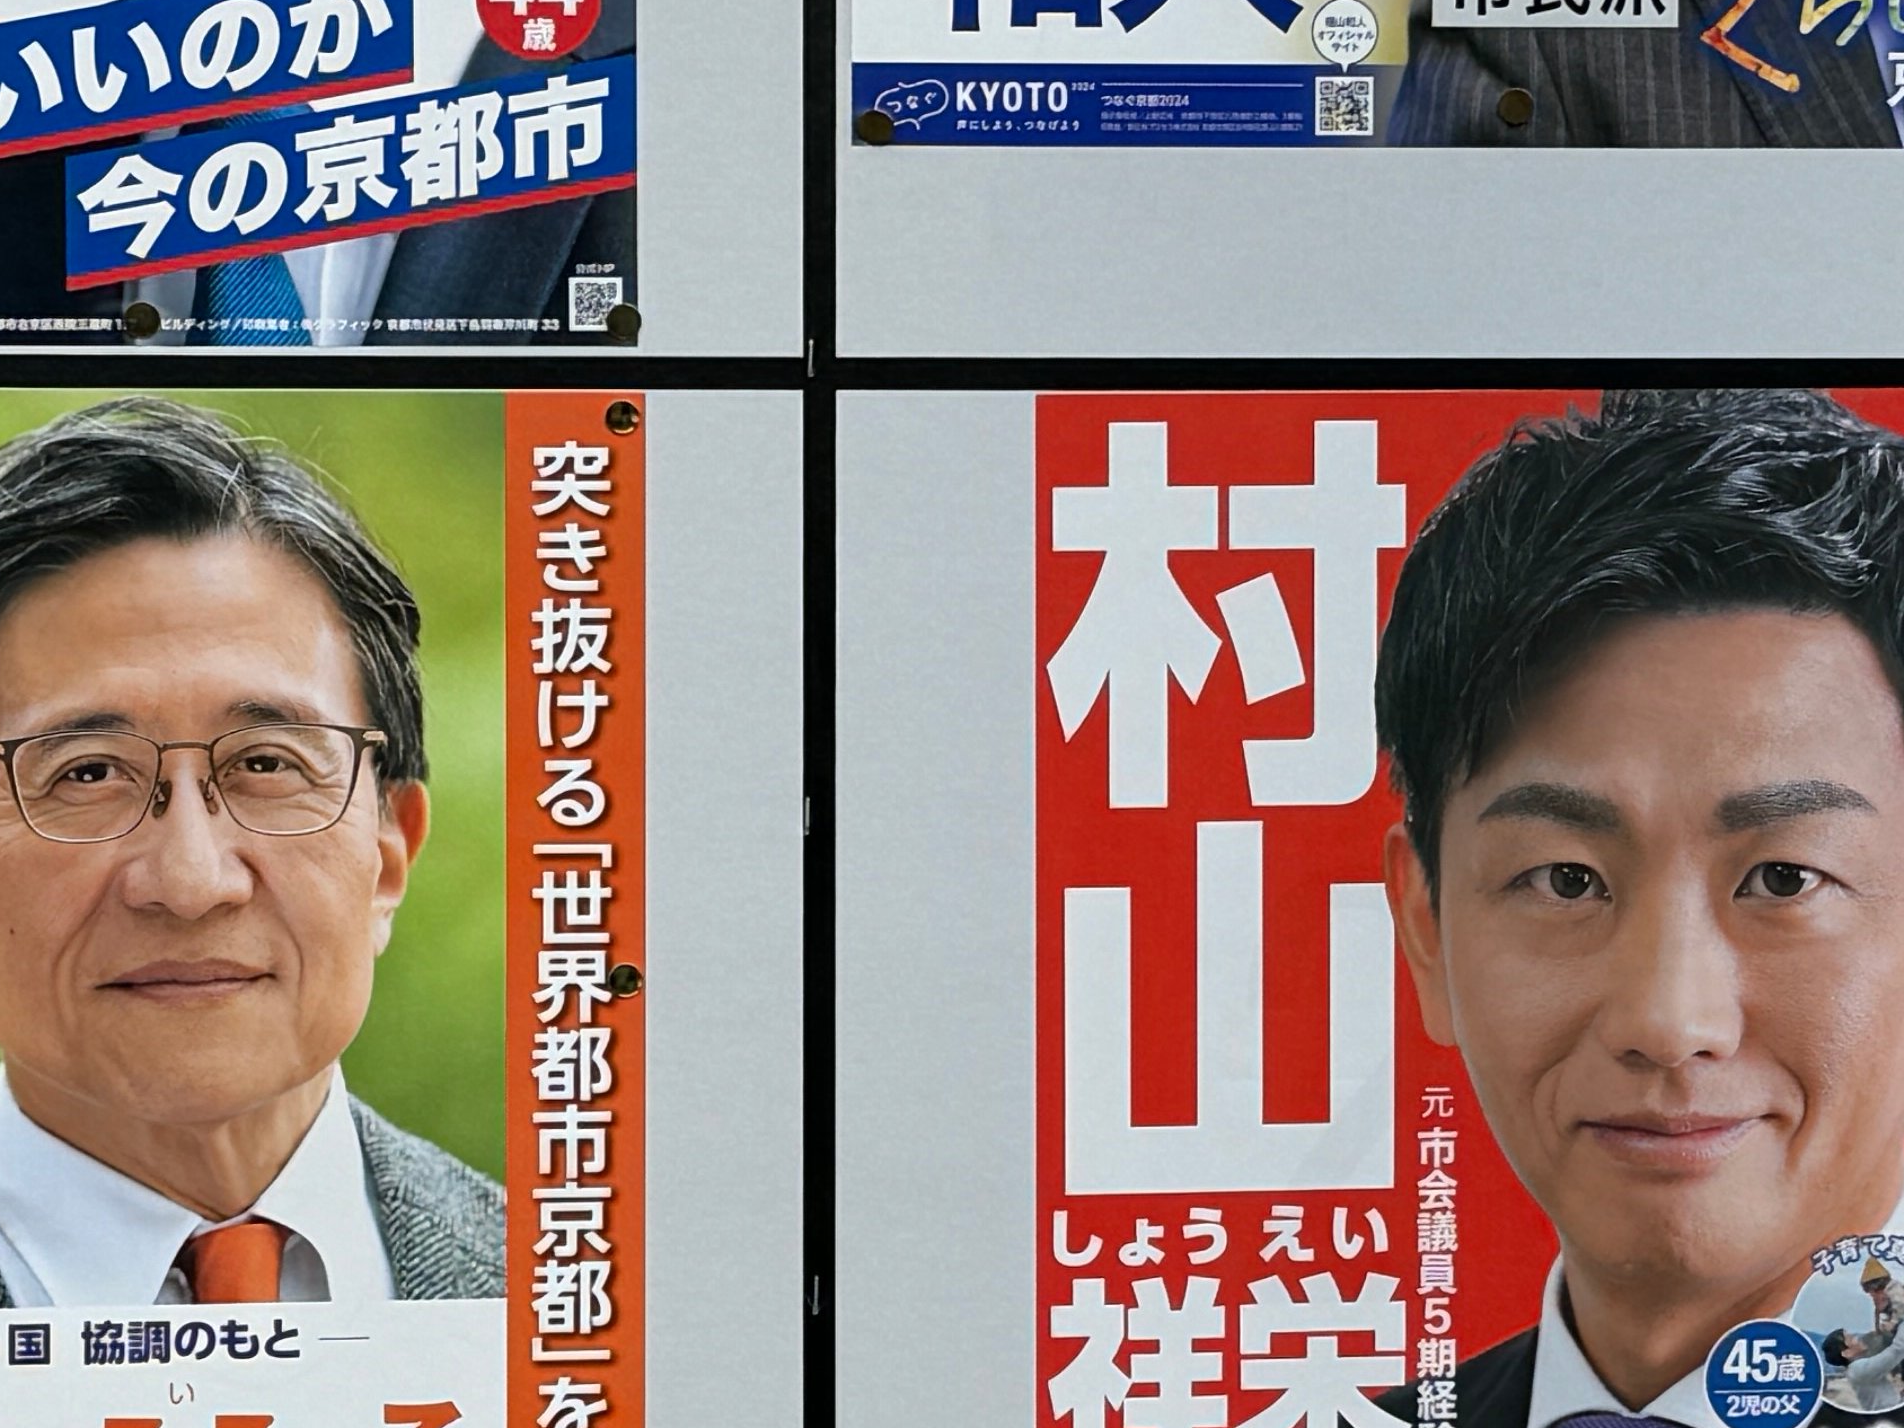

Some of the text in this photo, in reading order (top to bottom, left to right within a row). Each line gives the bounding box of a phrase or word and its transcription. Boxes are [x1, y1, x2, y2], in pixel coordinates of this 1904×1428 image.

[955, 80, 1069, 113] KYOTO
[75, 74, 612, 259] 今の京都市
[1045, 418, 1408, 1196] 村山
[1052, 1204, 1390, 1268] しょうえい
[81, 1318, 303, 1365] 協調のもと
[1722, 1338, 1807, 1385] 45歳
[1726, 1394, 1802, 1418] 2児の父
